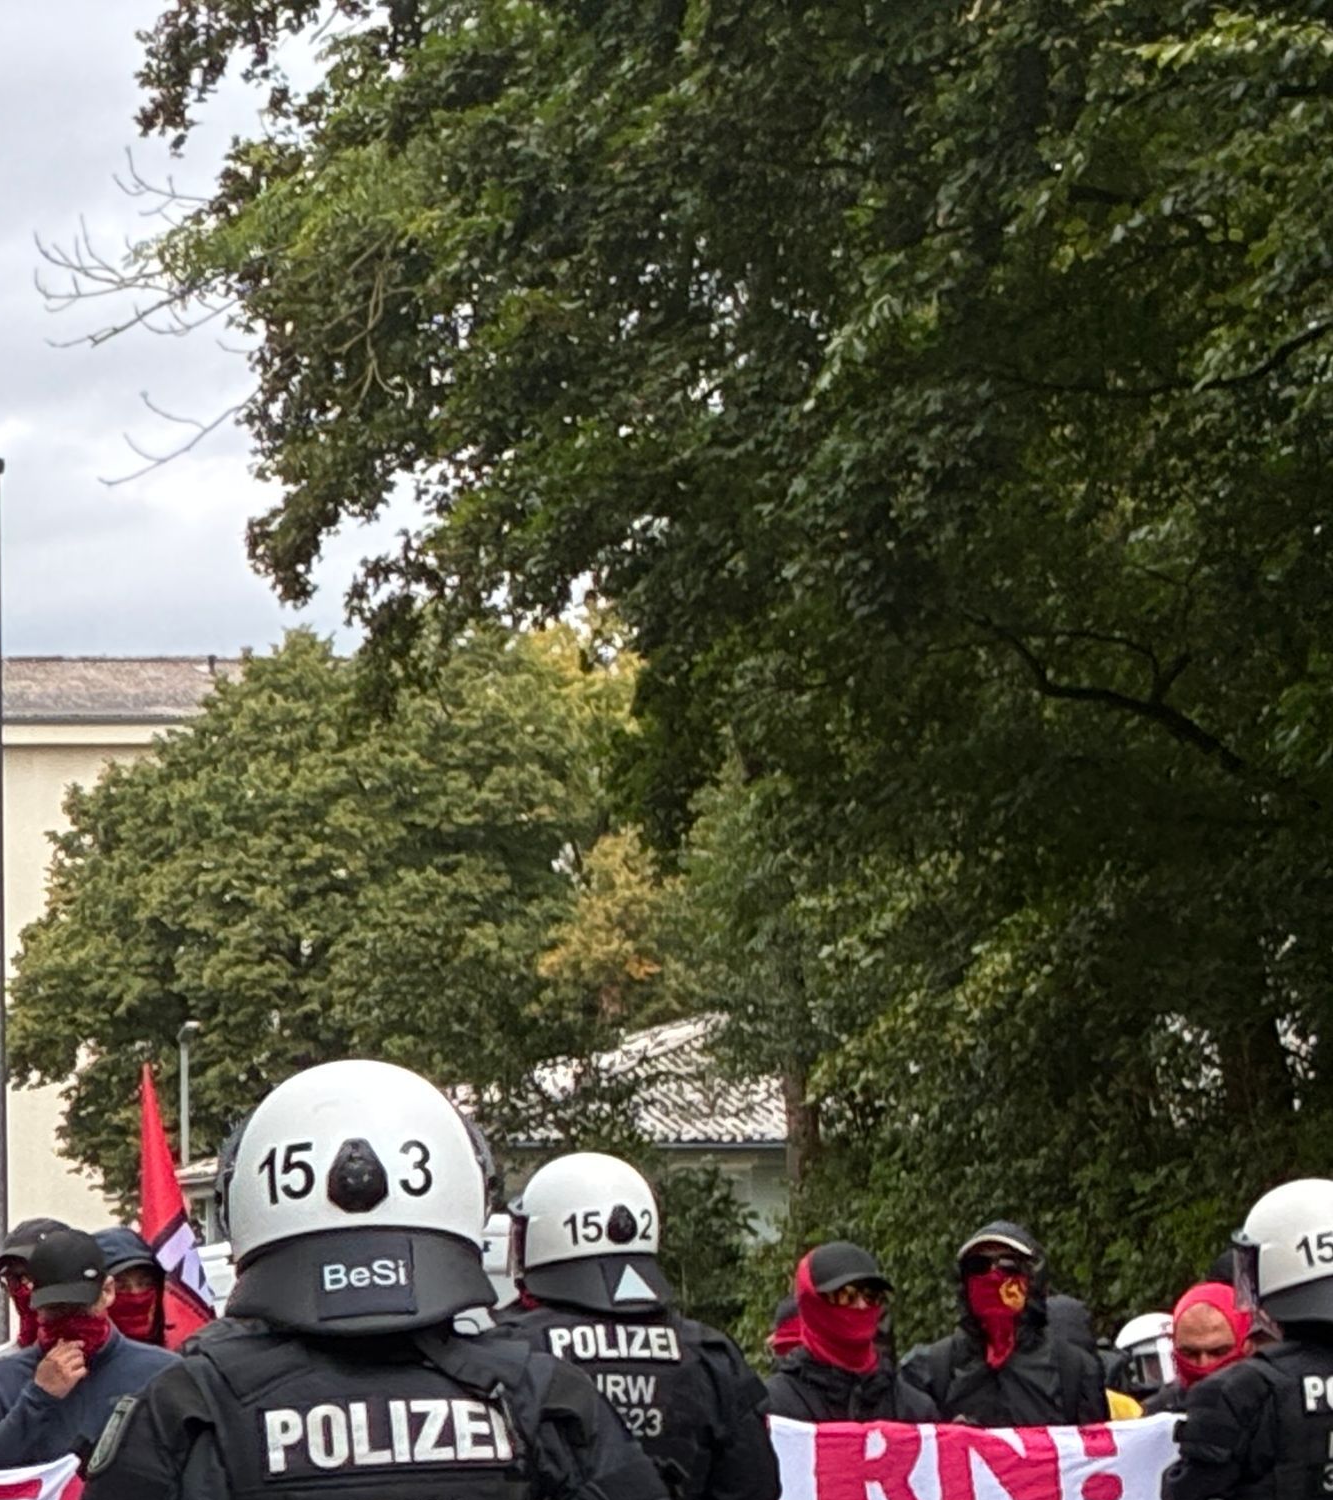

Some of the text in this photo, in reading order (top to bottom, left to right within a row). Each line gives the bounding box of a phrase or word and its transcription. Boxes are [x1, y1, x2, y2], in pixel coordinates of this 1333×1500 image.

[258, 1139, 434, 1205] 15 3
[563, 1209, 653, 1246] 15 2
[321, 1259, 409, 1292] BeSi
[549, 1324, 682, 1362] POLIZEI
[264, 1399, 513, 1473] POLIZEI
